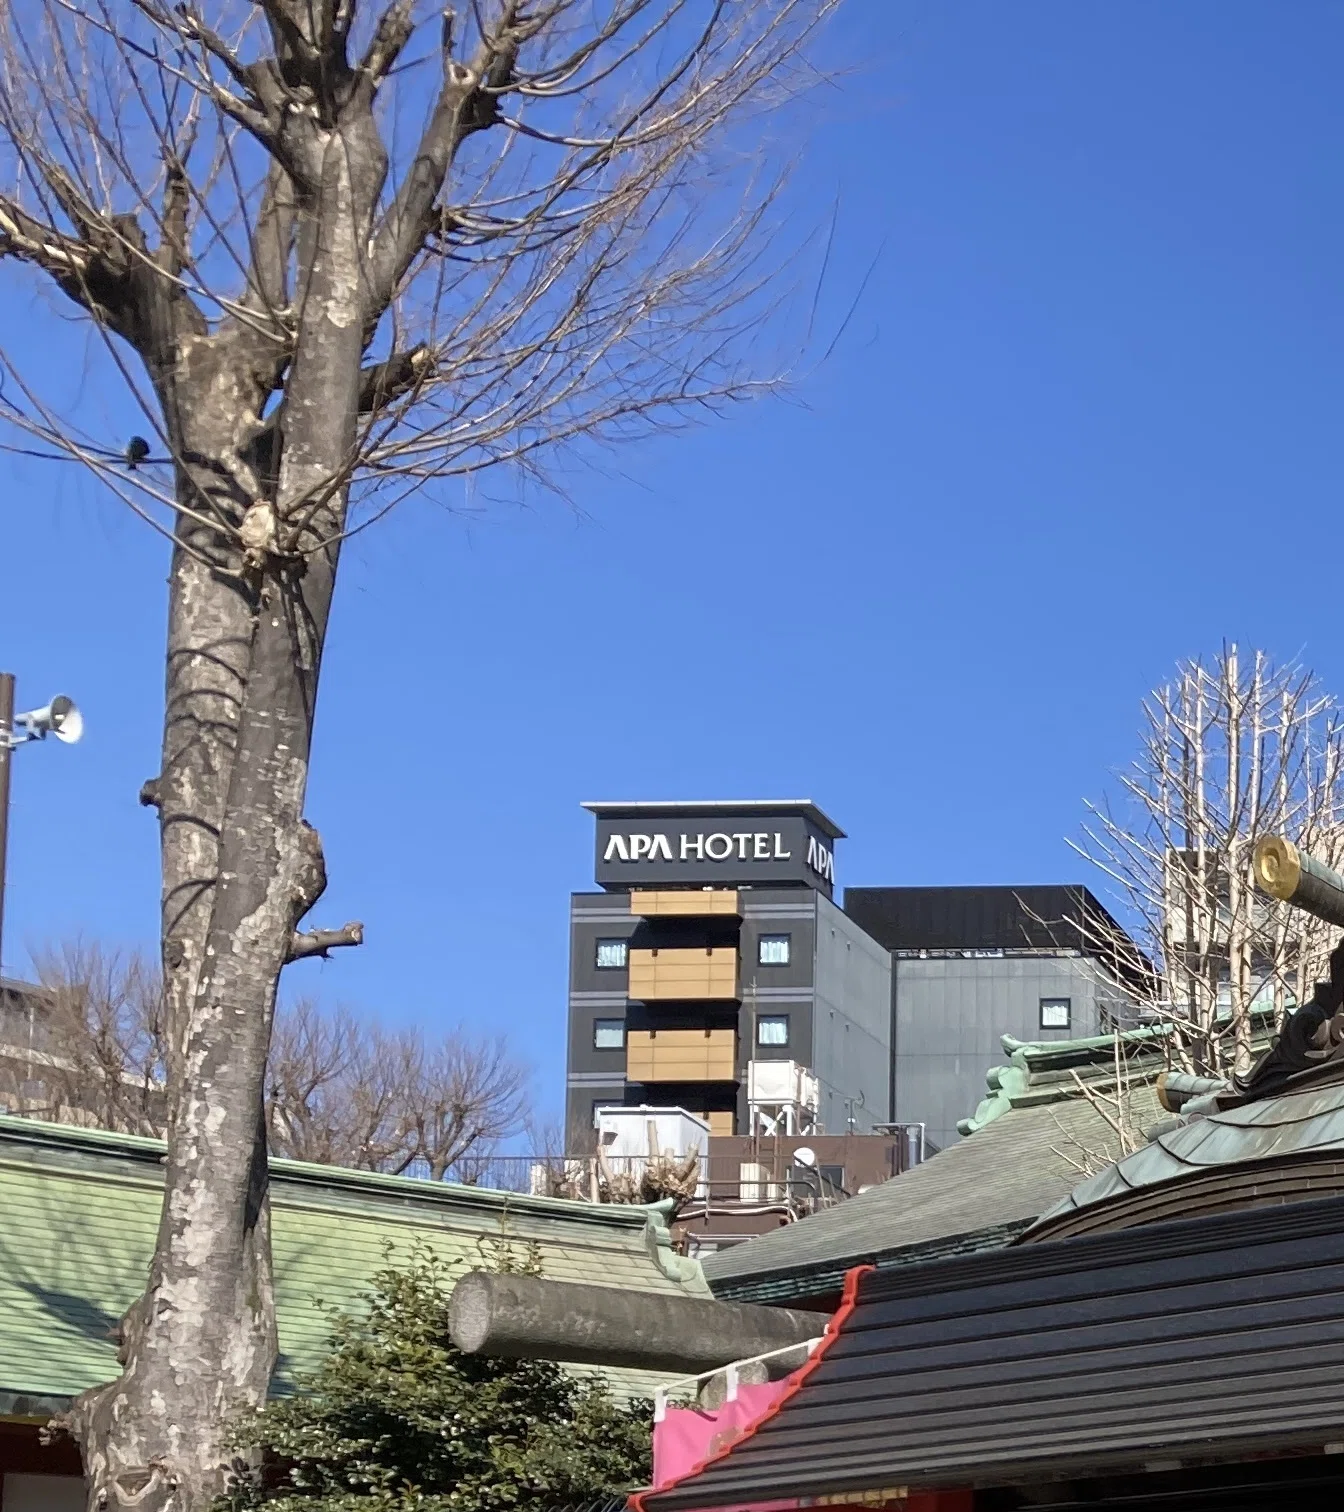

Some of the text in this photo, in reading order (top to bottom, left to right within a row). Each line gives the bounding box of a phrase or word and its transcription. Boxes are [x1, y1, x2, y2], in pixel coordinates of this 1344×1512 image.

[603, 833, 791, 860] APA HOTEL
[807, 836, 835, 885] APA
